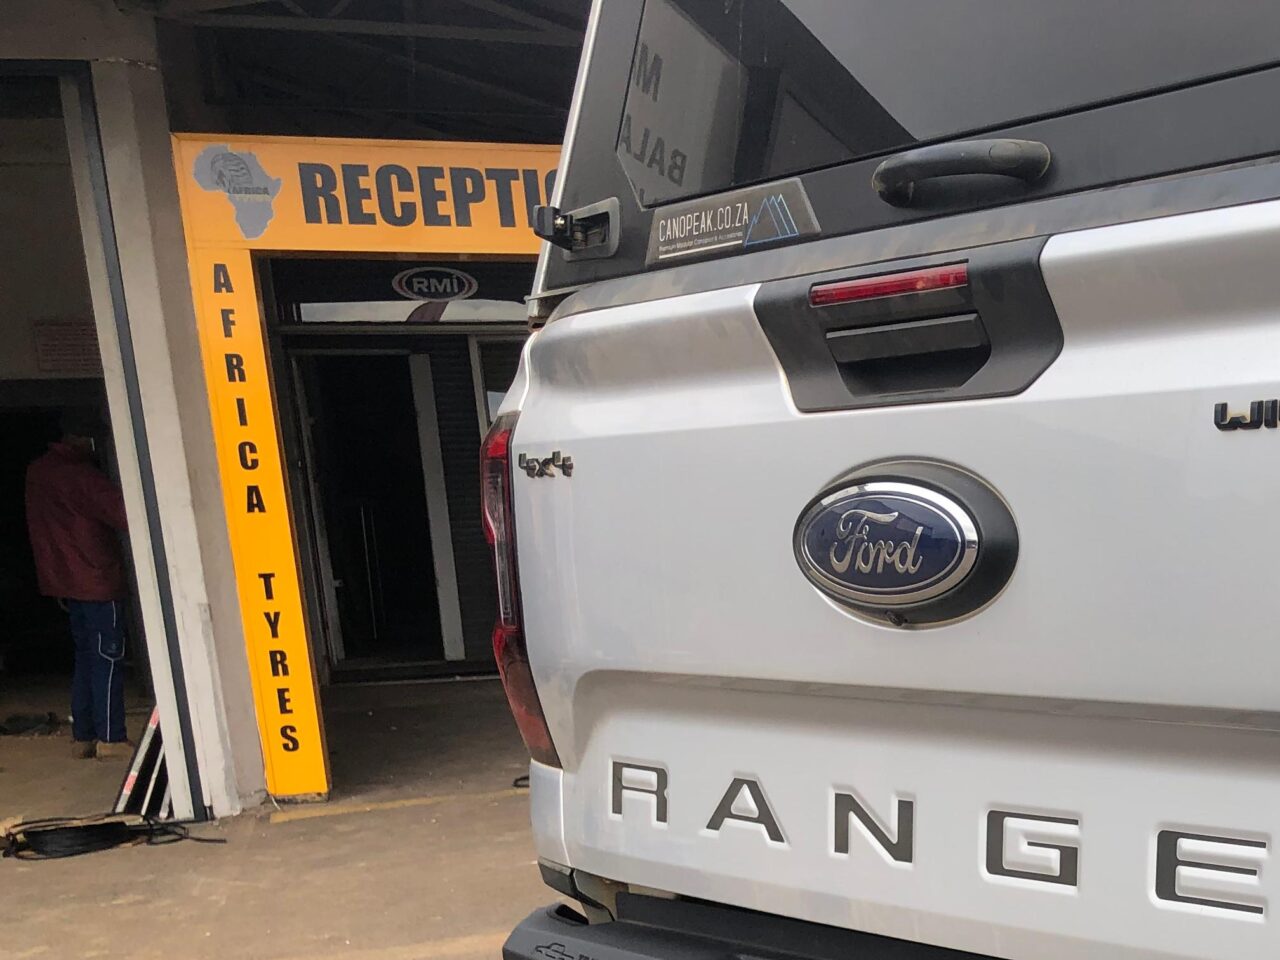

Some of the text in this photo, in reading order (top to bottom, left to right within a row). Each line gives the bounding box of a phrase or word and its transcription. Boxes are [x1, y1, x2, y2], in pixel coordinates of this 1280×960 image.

[298, 162, 558, 229] RECEPTI
[659, 202, 749, 242] CANOPEAK.CO.ZA
[213, 264, 300, 752] AFRICA TYRES
[829, 509, 924, 575] Ford
